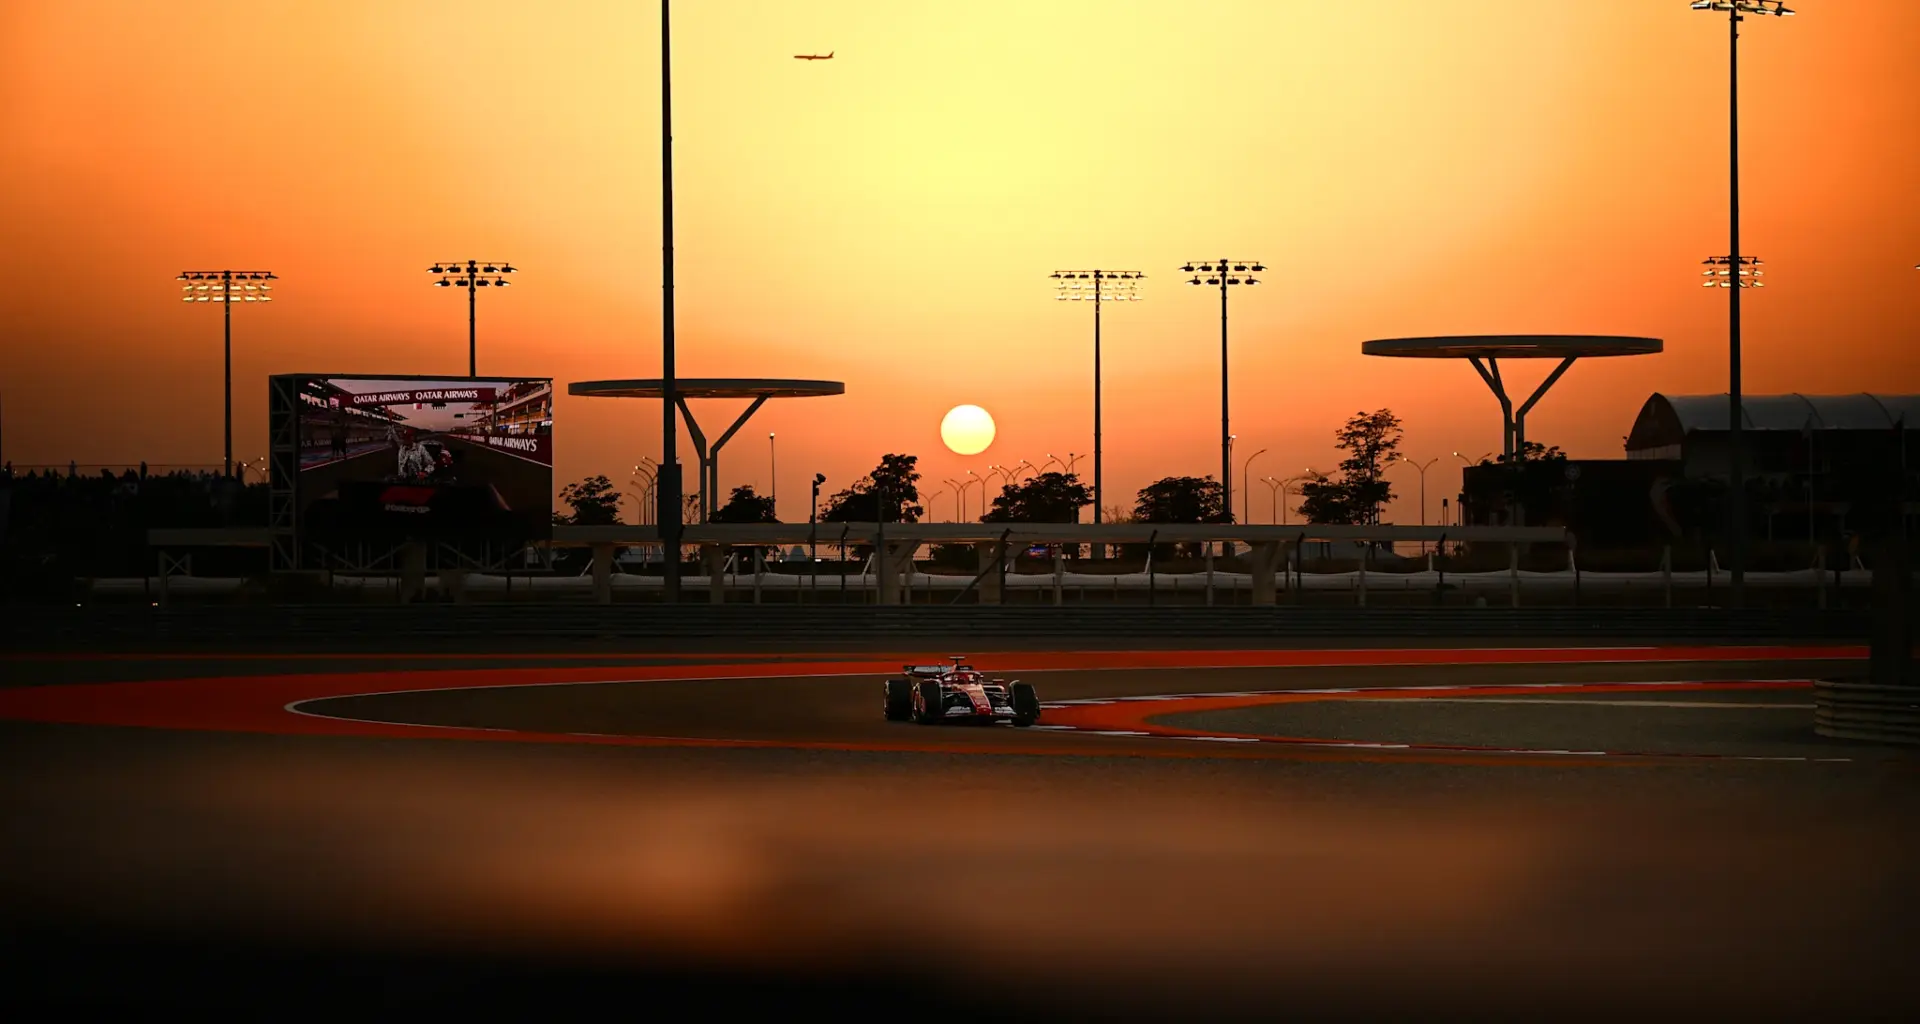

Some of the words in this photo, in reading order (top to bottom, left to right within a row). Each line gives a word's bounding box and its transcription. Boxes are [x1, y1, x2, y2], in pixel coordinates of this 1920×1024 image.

[353, 395, 377, 404] QATAR
[378, 392, 410, 402] AIRWAYS
[415, 391, 442, 400] QATAR
[443, 390, 478, 399] AIRWAYS
[488, 436, 503, 446] QATAR
[503, 437, 538, 452] AIRWAYS
